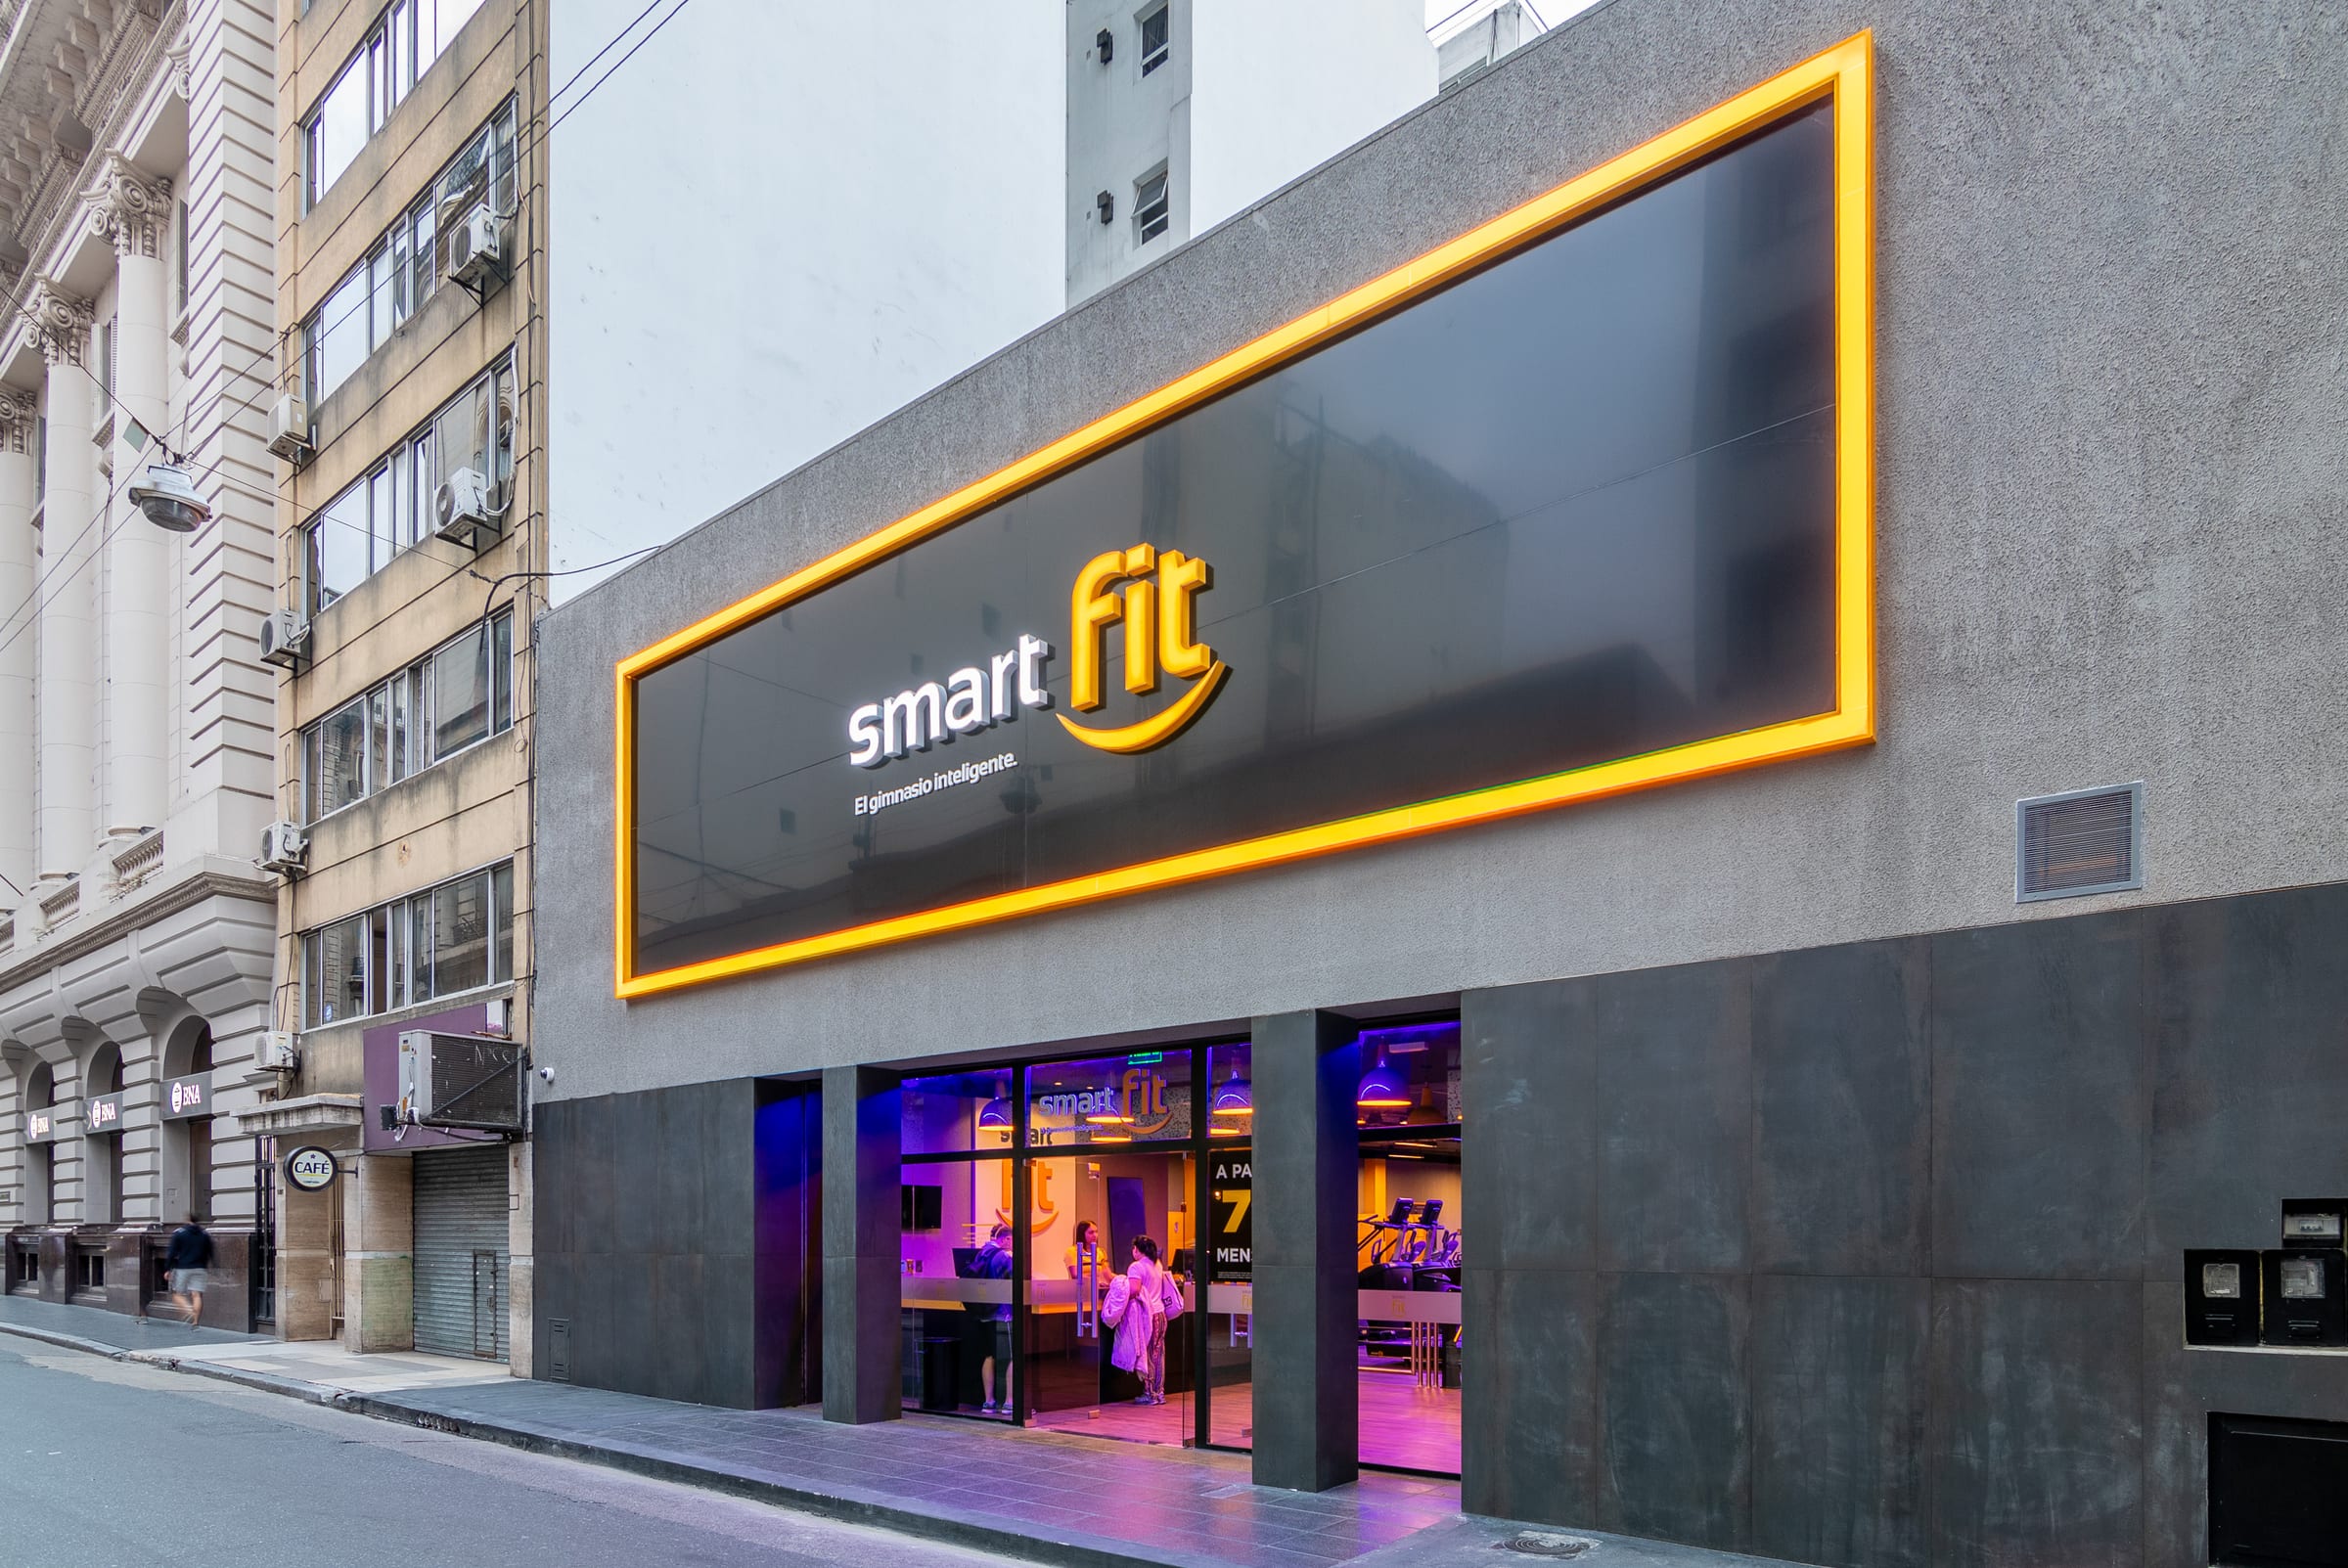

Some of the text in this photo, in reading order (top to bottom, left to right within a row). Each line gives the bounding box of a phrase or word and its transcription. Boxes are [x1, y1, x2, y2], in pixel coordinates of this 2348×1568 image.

[848, 542, 1211, 767] smart fit
[854, 752, 1018, 816] El gimnasio inteligente.
[183, 1084, 202, 1106] BNA
[1039, 1068, 1169, 1117] smart fit
[101, 1101, 116, 1122] BNA
[36, 1116, 49, 1134] BNA
[294, 1160, 330, 1174] CAFÉ
[1215, 1163, 1252, 1180] A PA
[1216, 1247, 1252, 1263] MEN
